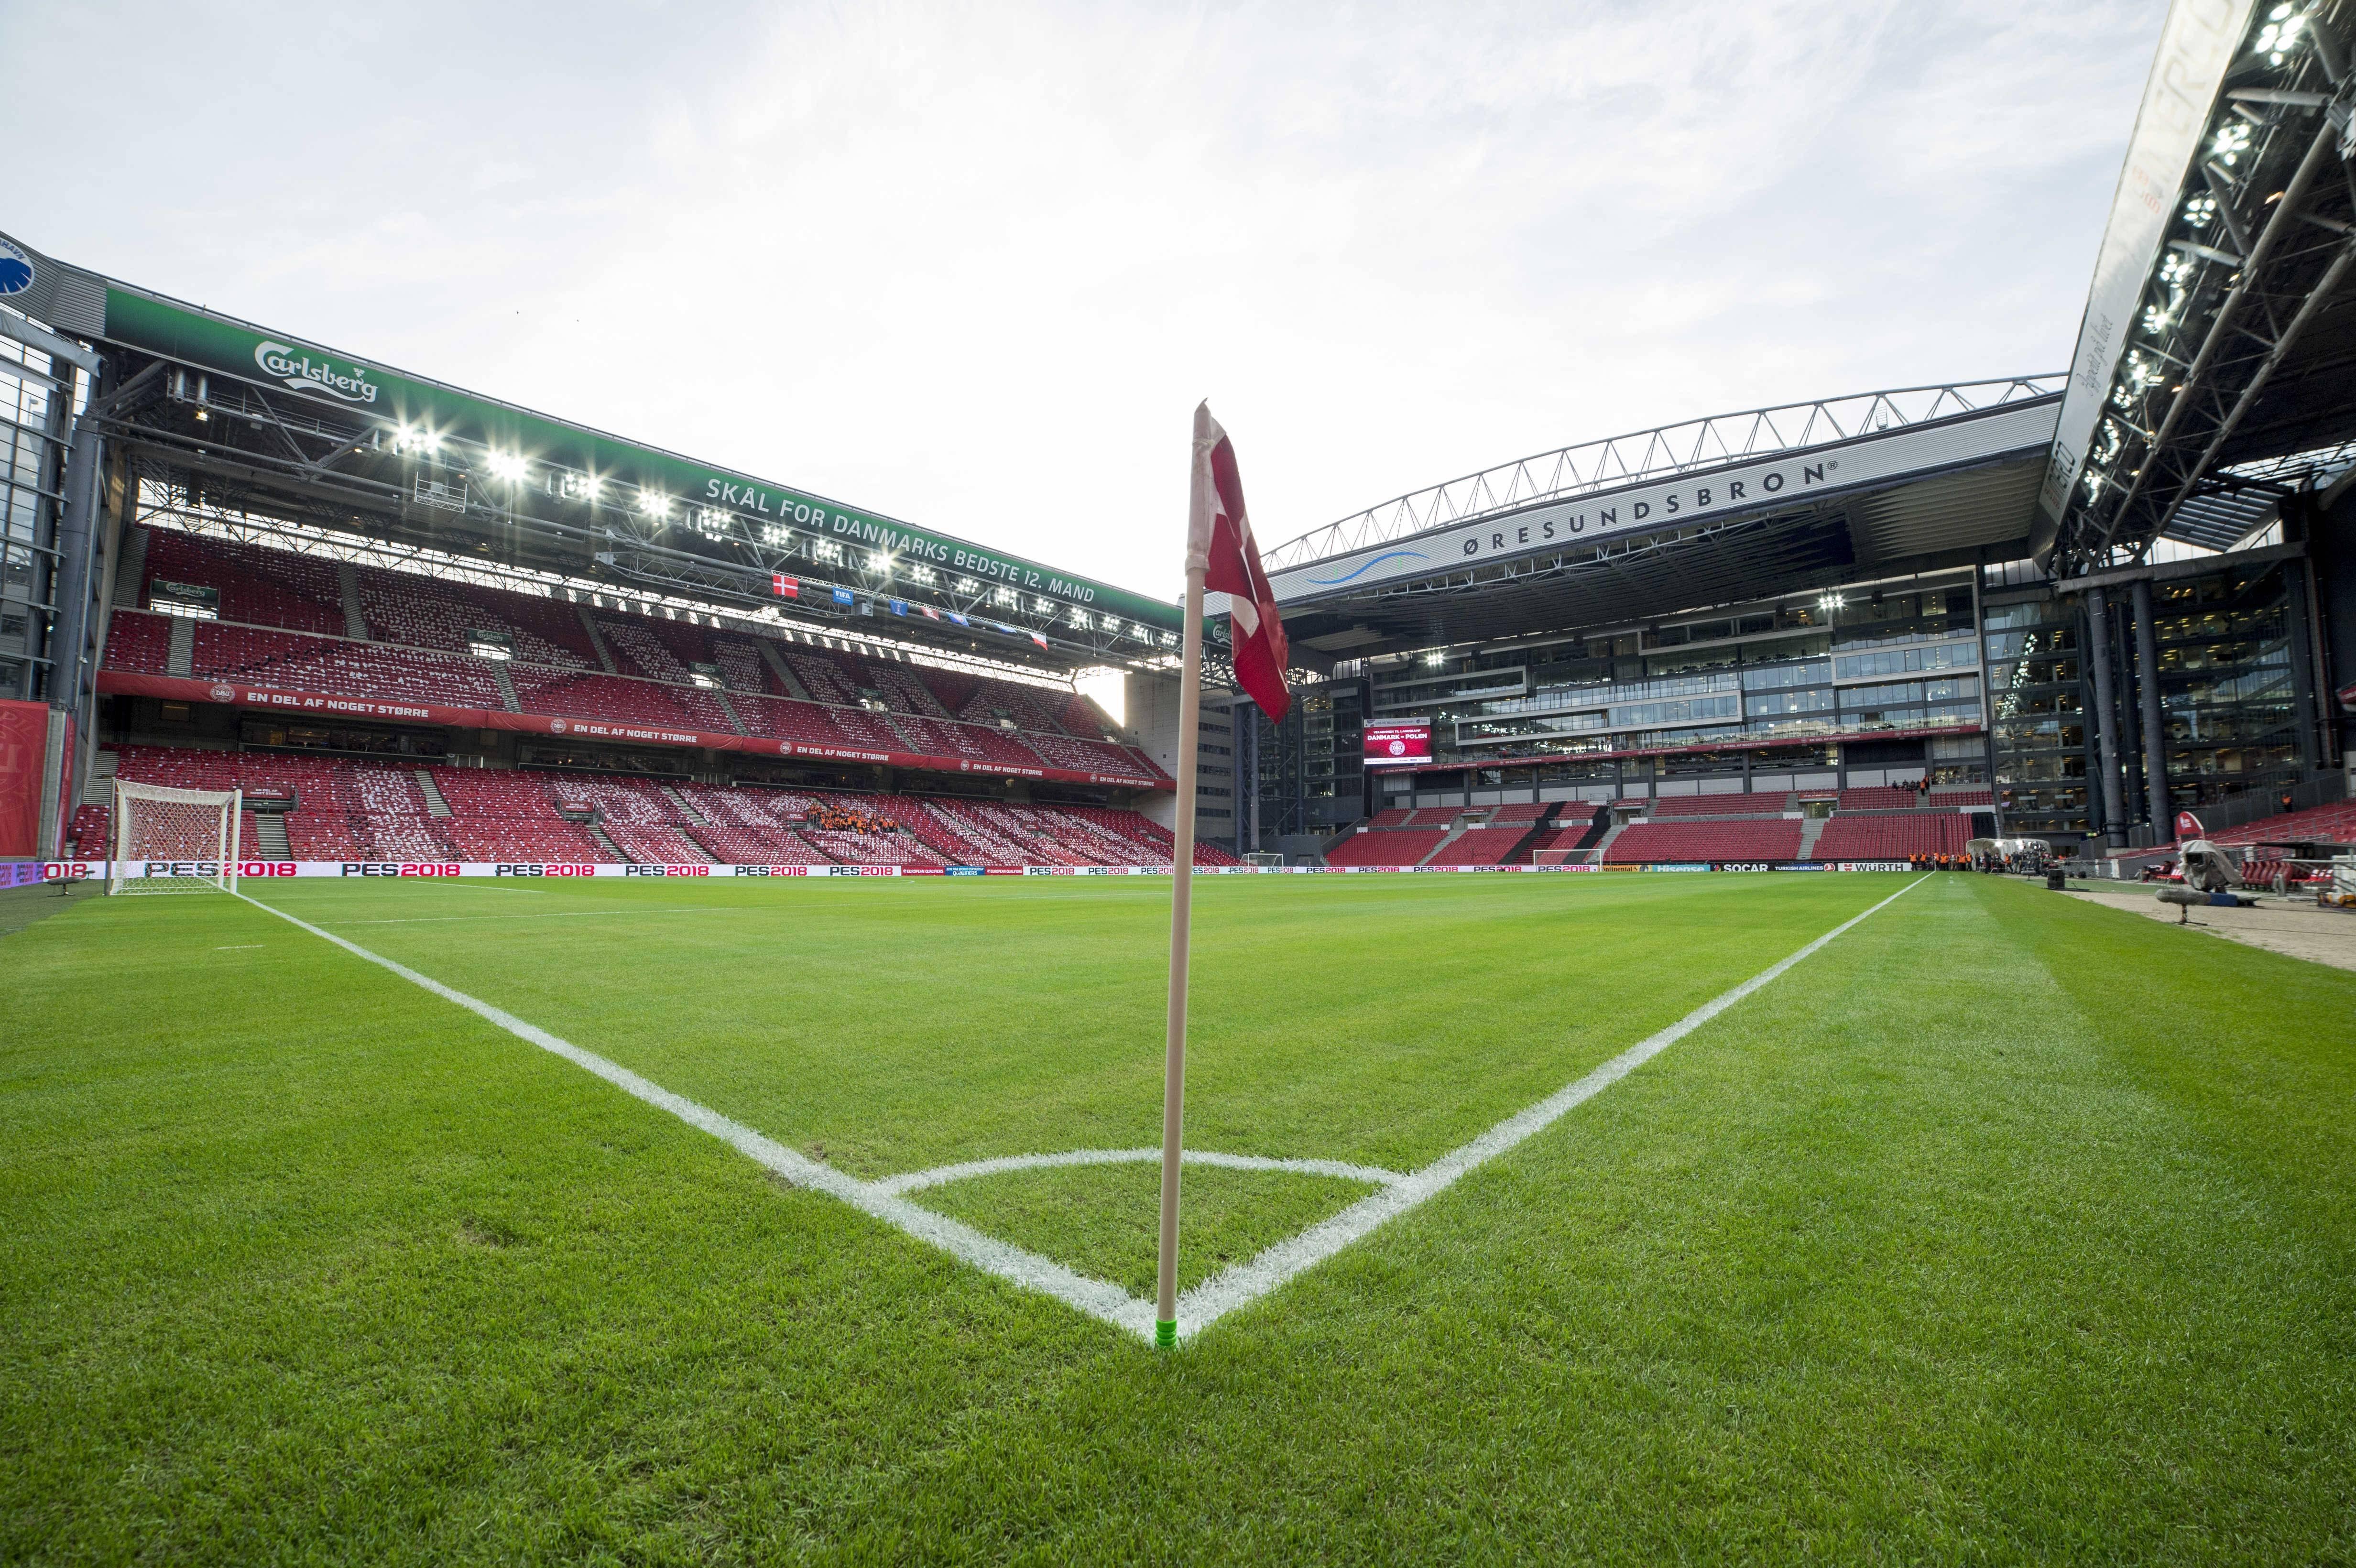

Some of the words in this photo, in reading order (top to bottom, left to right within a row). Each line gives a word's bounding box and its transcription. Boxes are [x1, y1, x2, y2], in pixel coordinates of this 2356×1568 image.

[255, 340, 379, 403] Carlsberg
[706, 479, 769, 512] SKÅL
[780, 500, 826, 527] FOR
[833, 515, 949, 561] DANMARKS
[954, 550, 1020, 582] BEDSTE
[1024, 570, 1042, 588] 12.
[1048, 578, 1094, 602] MAND
[166, 583, 205, 597] Carlsberg
[835, 590, 851, 599] FIFA
[477, 631, 503, 642] Carlsberg
[247, 692, 268, 703] EN
[272, 695, 300, 706] DEL
[304, 698, 324, 708] AF
[327, 700, 375, 713] NOGET
[378, 705, 428, 717] STØRRE
[574, 725, 588, 733] EN
[590, 726, 609, 735] DEL
[627, 730, 660, 740] NOGET
[662, 733, 697, 742] STØRRE
[837, 750, 861, 758] NOGET
[862, 752, 889, 761] STØRRE
[342, 863, 460, 877] PES2018
[498, 864, 595, 876] PES2018
[626, 865, 709, 877] PES2018
[735, 866, 807, 877] PES2018
[830, 867, 893, 876] PES2018
[1723, 864, 1768, 872] SOCAR
